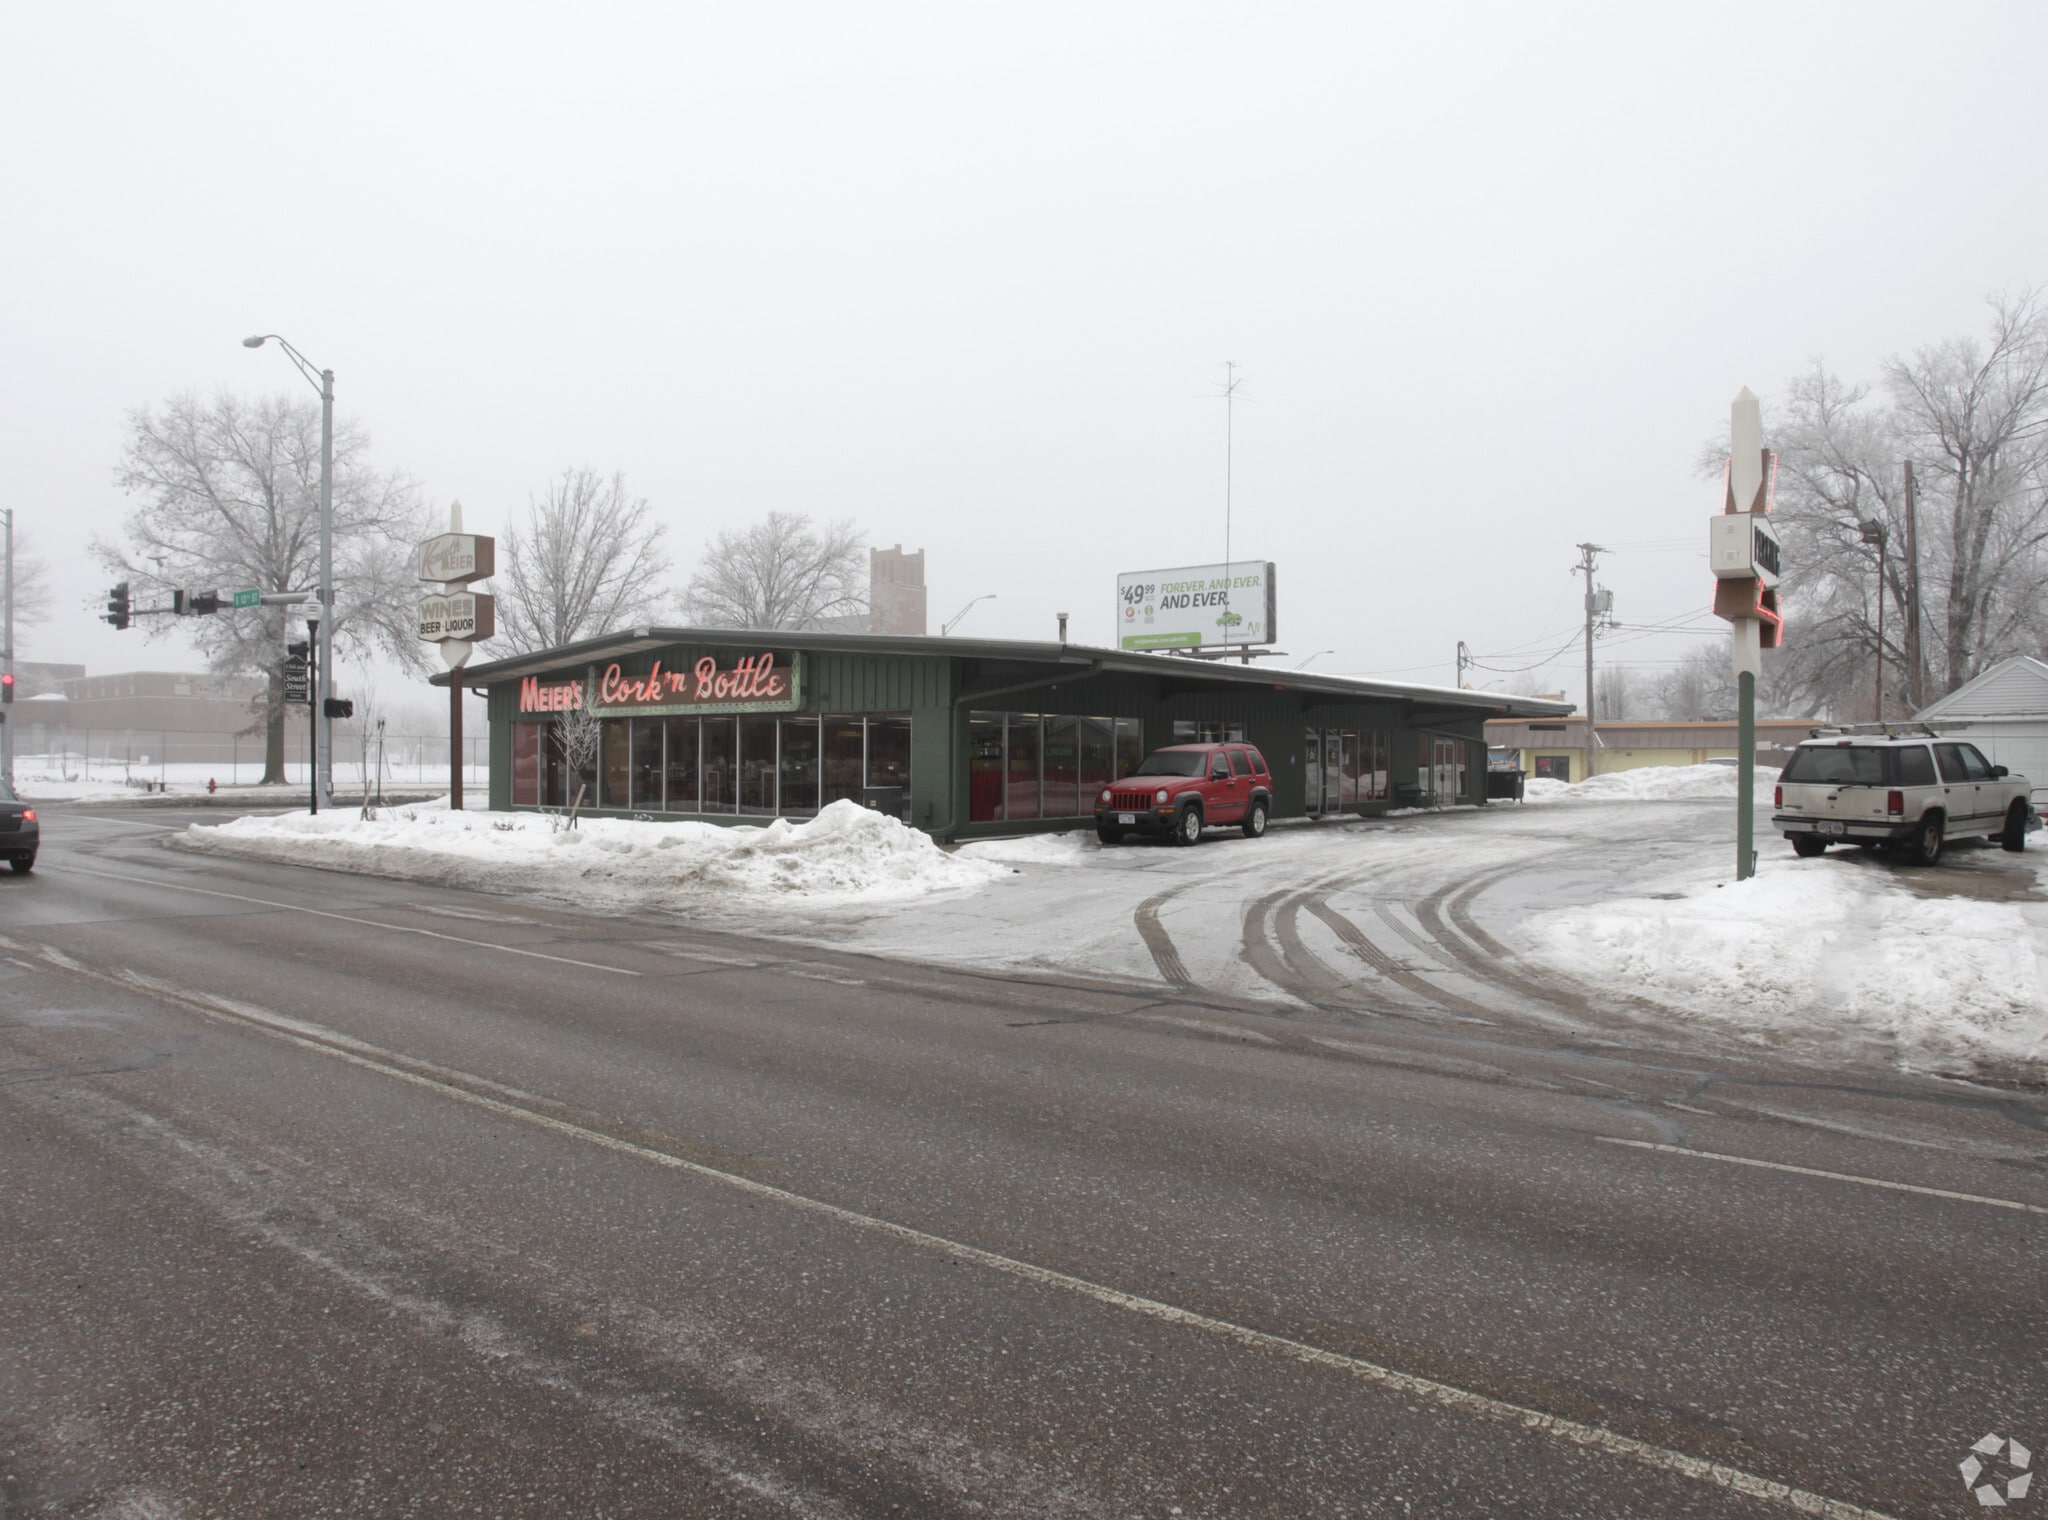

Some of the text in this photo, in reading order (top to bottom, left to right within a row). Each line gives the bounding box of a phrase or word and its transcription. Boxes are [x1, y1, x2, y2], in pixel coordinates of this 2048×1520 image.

[1160, 575, 1262, 594] FOREVER. AND EVER.
[420, 599, 473, 620] WINES
[1160, 591, 1230, 610] AND EVER.
[420, 618, 474, 634] BEER LIQUOR
[285, 674, 306, 682] South
[601, 660, 664, 703] Cork
[694, 652, 786, 701] Bottle
